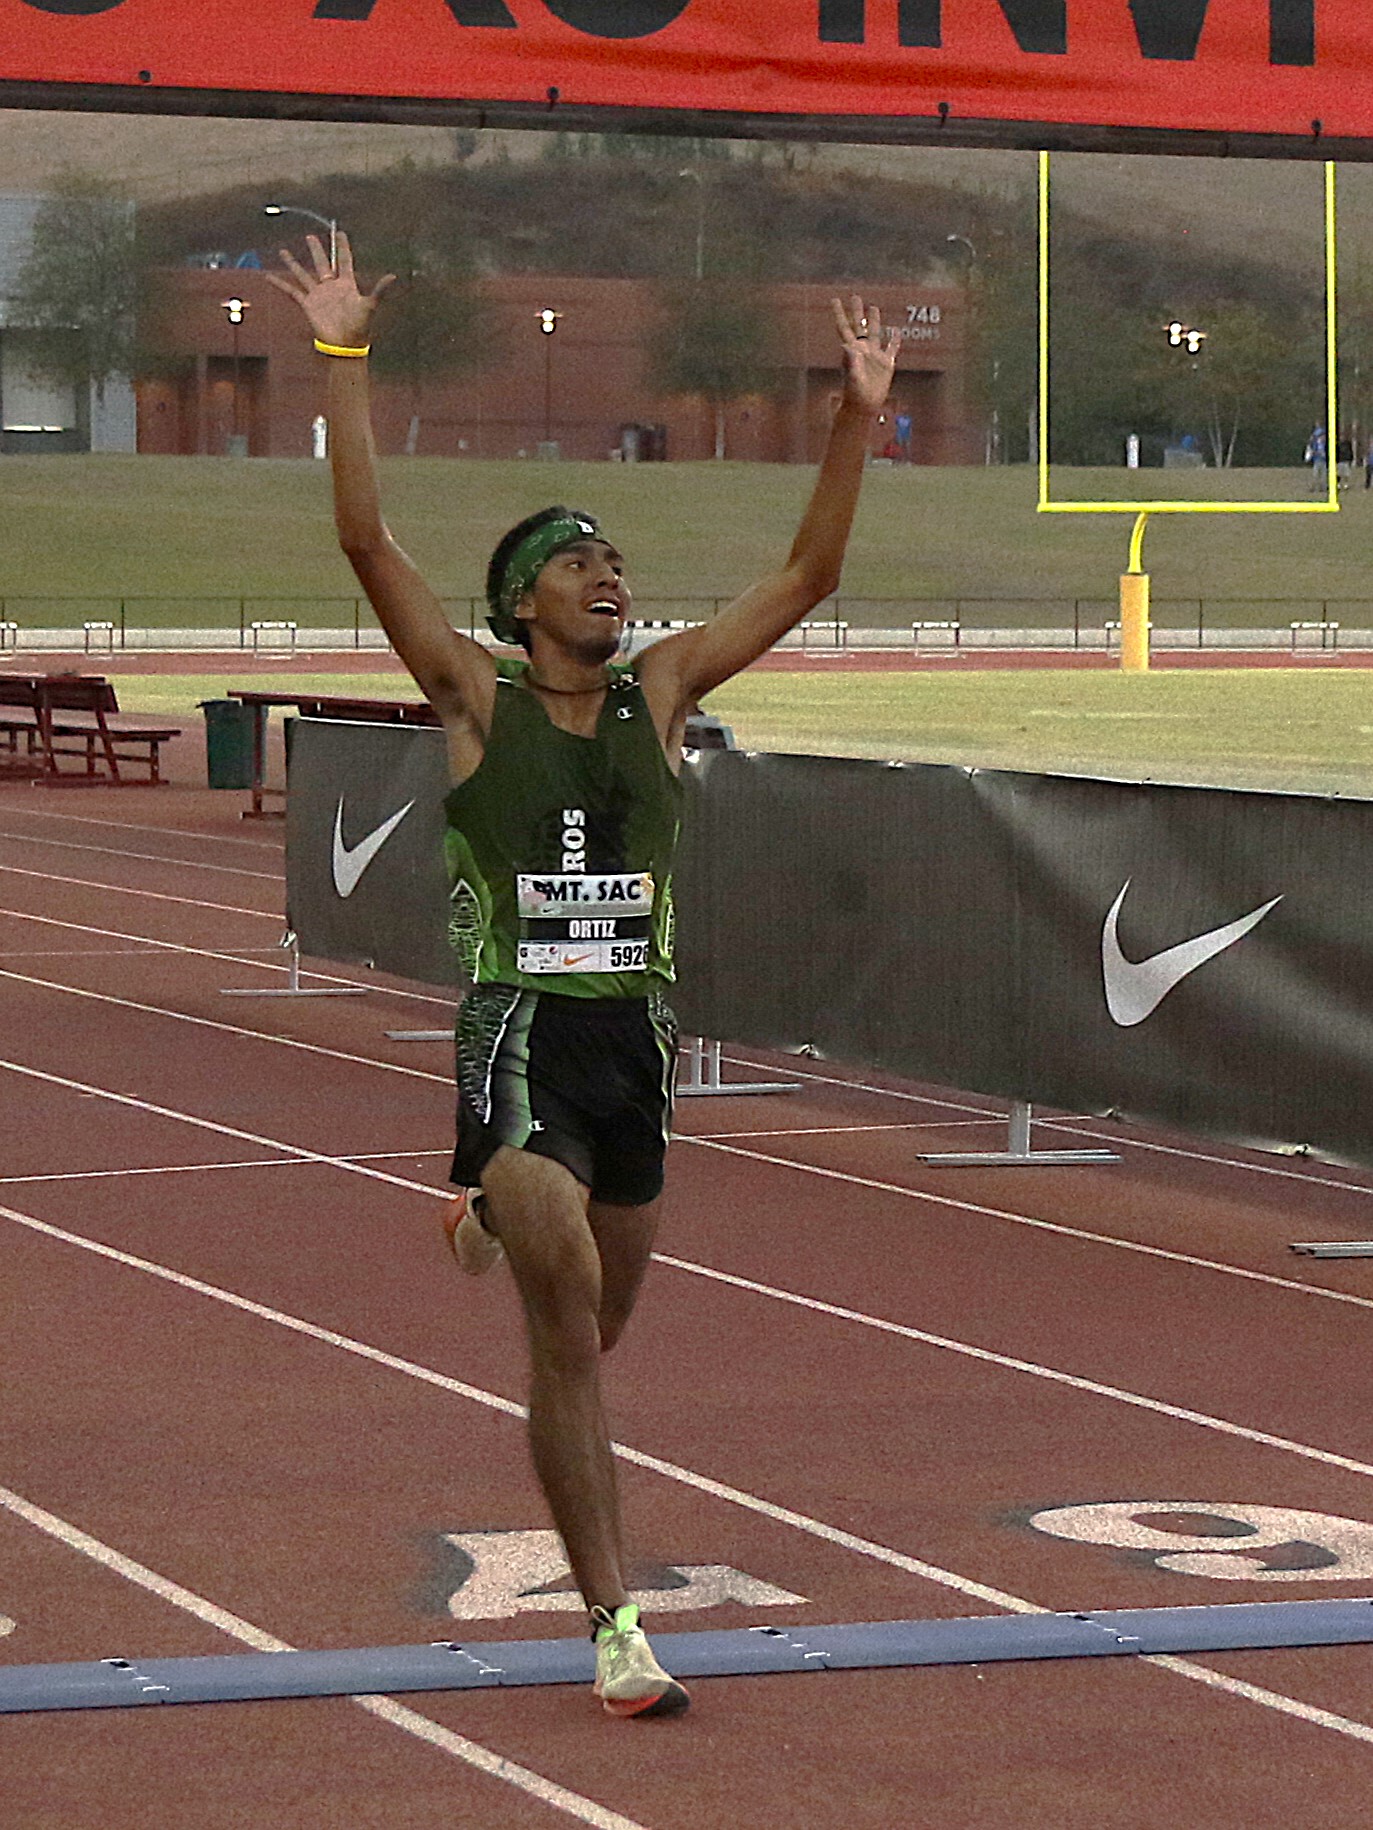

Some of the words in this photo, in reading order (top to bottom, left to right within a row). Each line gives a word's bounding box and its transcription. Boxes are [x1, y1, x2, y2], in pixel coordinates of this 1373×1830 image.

[546, 881, 590, 901] MT.
[597, 880, 641, 900] SAC
[569, 919, 617, 938] ORTIZ
